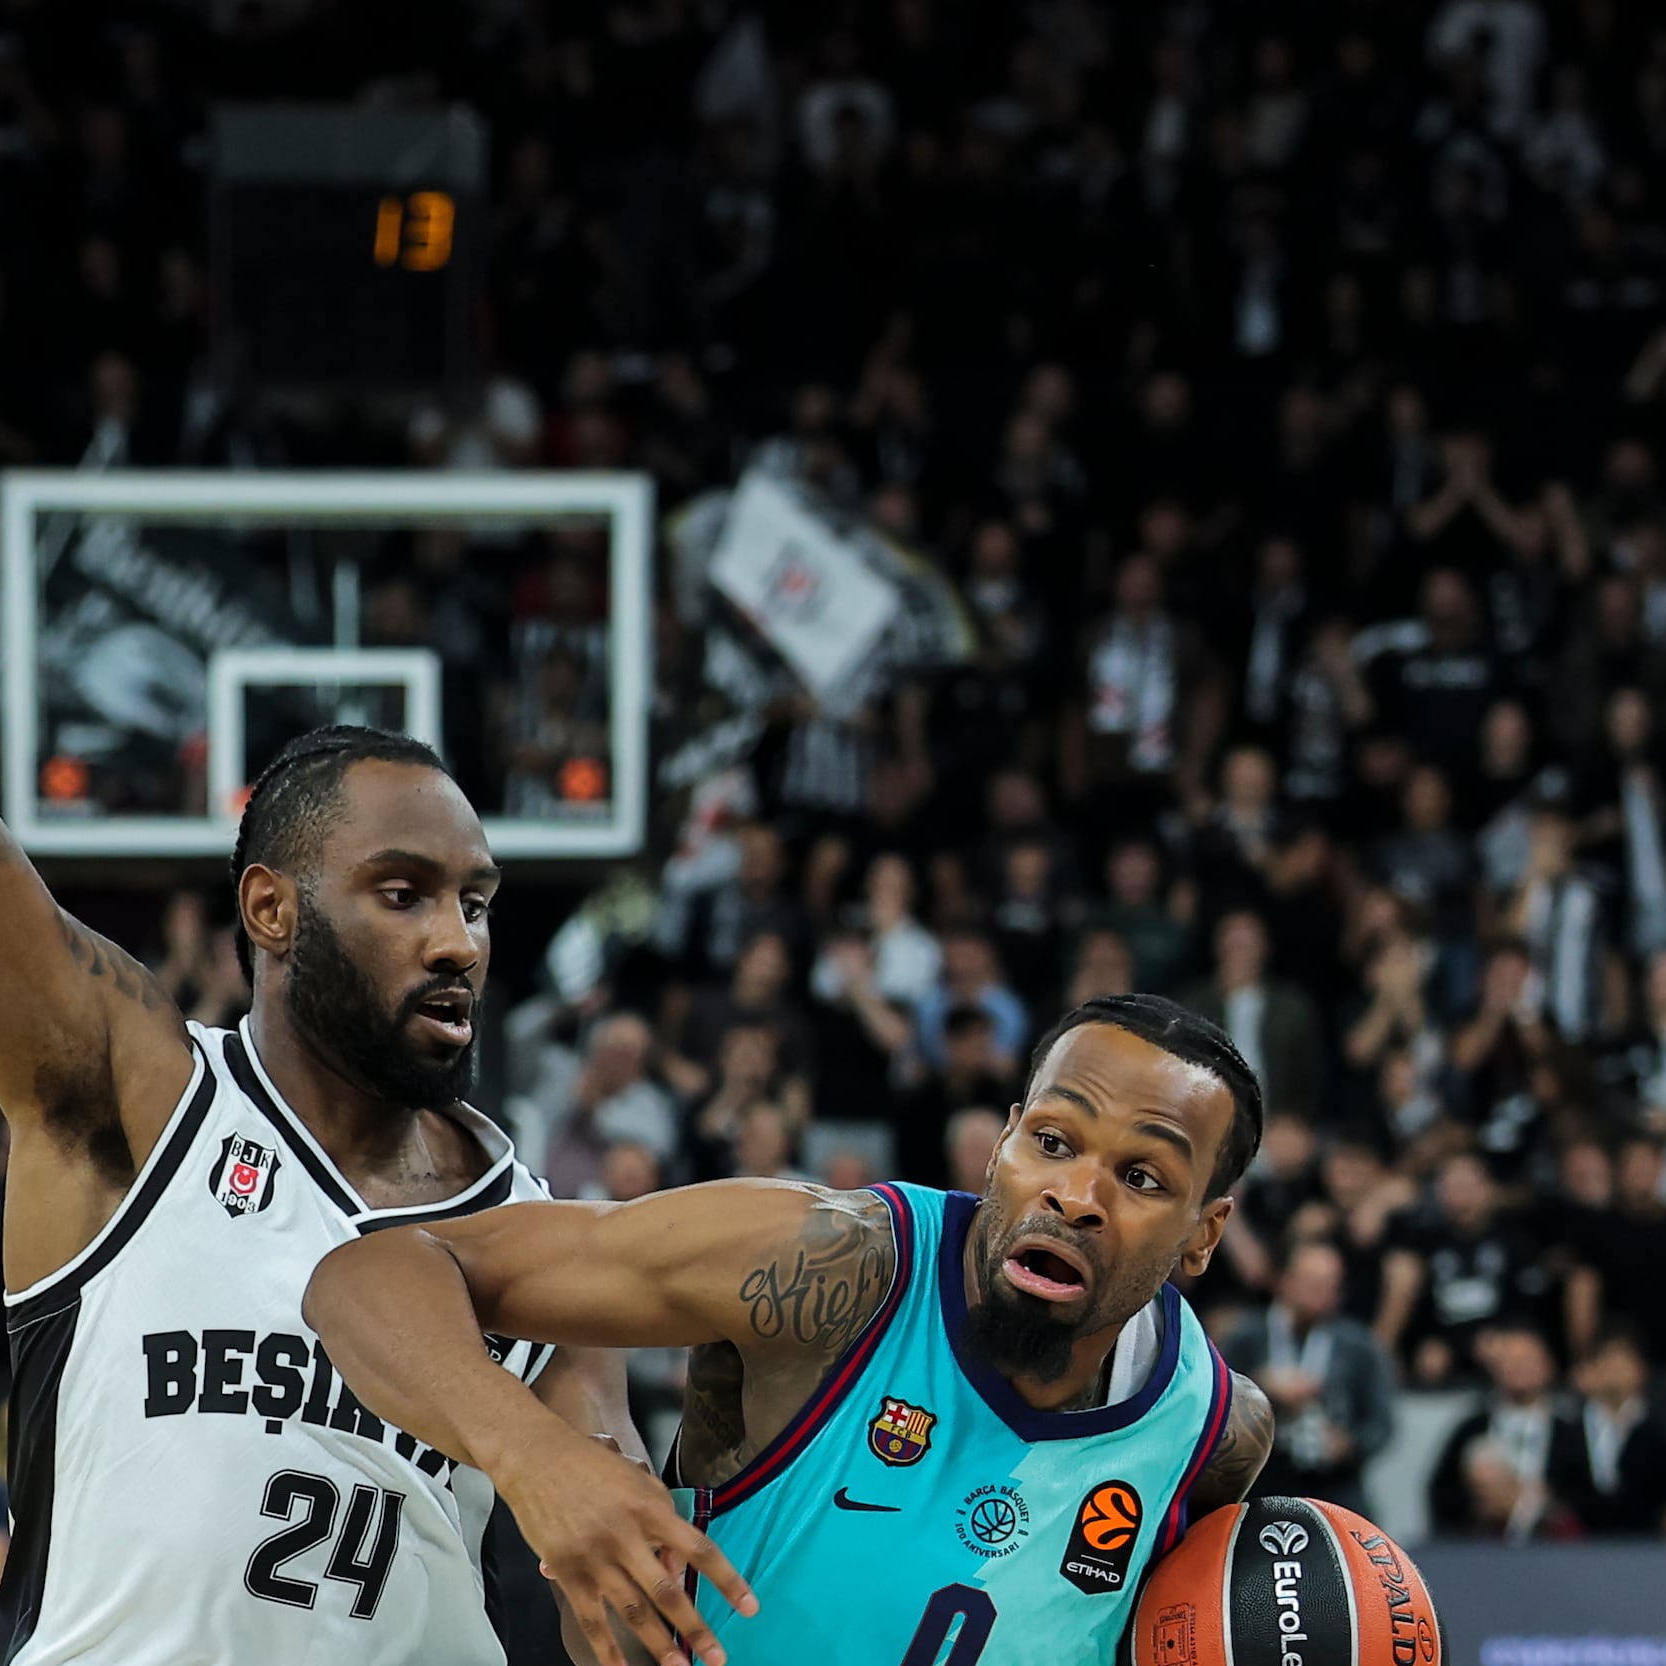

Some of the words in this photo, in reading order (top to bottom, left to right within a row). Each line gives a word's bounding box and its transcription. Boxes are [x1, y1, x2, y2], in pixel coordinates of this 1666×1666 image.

[373, 191, 455, 272] 13
[231, 1141, 271, 1168] BJK
[221, 1192, 256, 1212] 1903
[890, 1426, 912, 1439] FCB
[964, 1485, 996, 1505] BARÇA
[244, 1469, 407, 1621] 24
[955, 1523, 967, 1540] 100
[963, 1541, 1020, 1558] ANIVERSARI
[1066, 1562, 1120, 1583] ETIHAD
